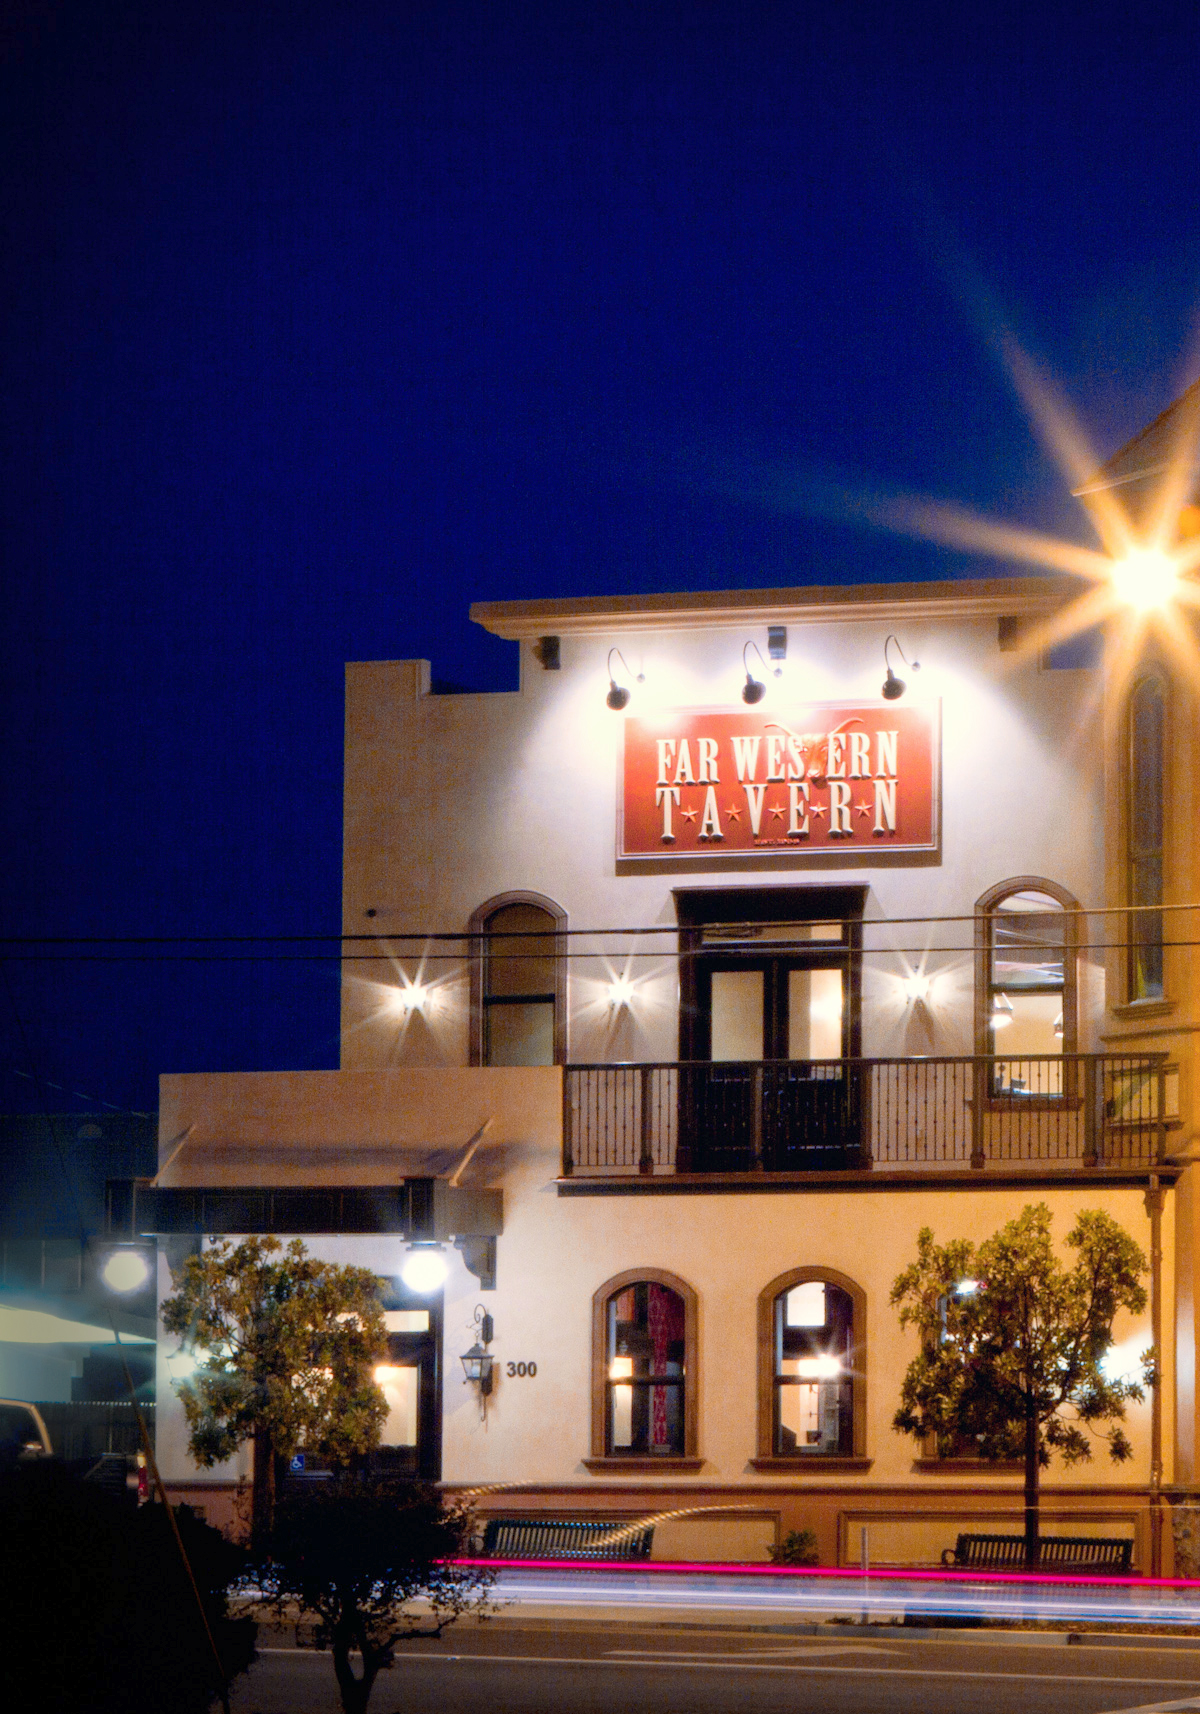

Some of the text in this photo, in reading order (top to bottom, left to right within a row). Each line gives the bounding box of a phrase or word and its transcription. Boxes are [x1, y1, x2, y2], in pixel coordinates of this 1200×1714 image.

[656, 731, 899, 786] FAR WESERN
[656, 779, 899, 842] TAVERN
[506, 1361, 538, 1378] 300
